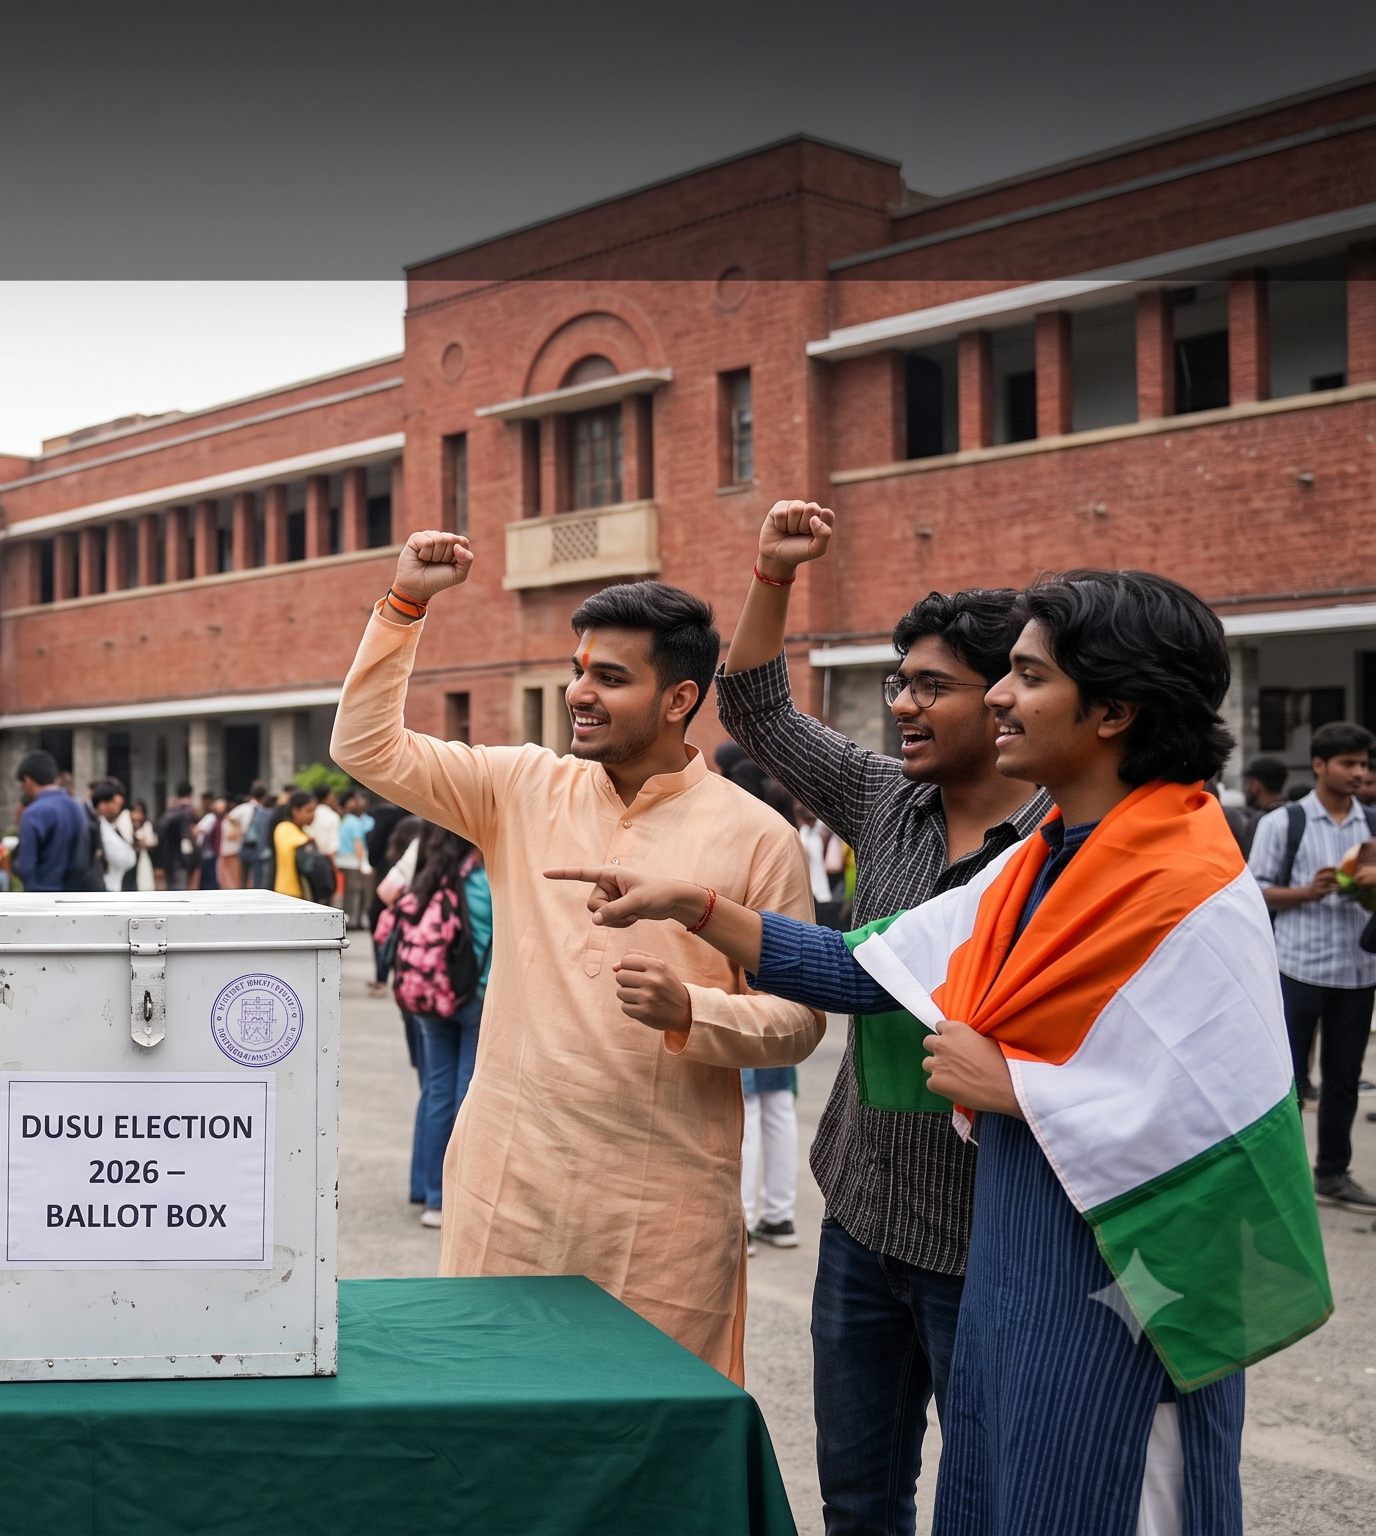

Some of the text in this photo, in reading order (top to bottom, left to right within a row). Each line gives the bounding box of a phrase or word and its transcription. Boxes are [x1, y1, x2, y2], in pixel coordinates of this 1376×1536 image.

[22, 1114, 252, 1139] DUSU ELECTION
[89, 1159, 159, 1183] 2026
[46, 1203, 227, 1228] BALLOT BOX
